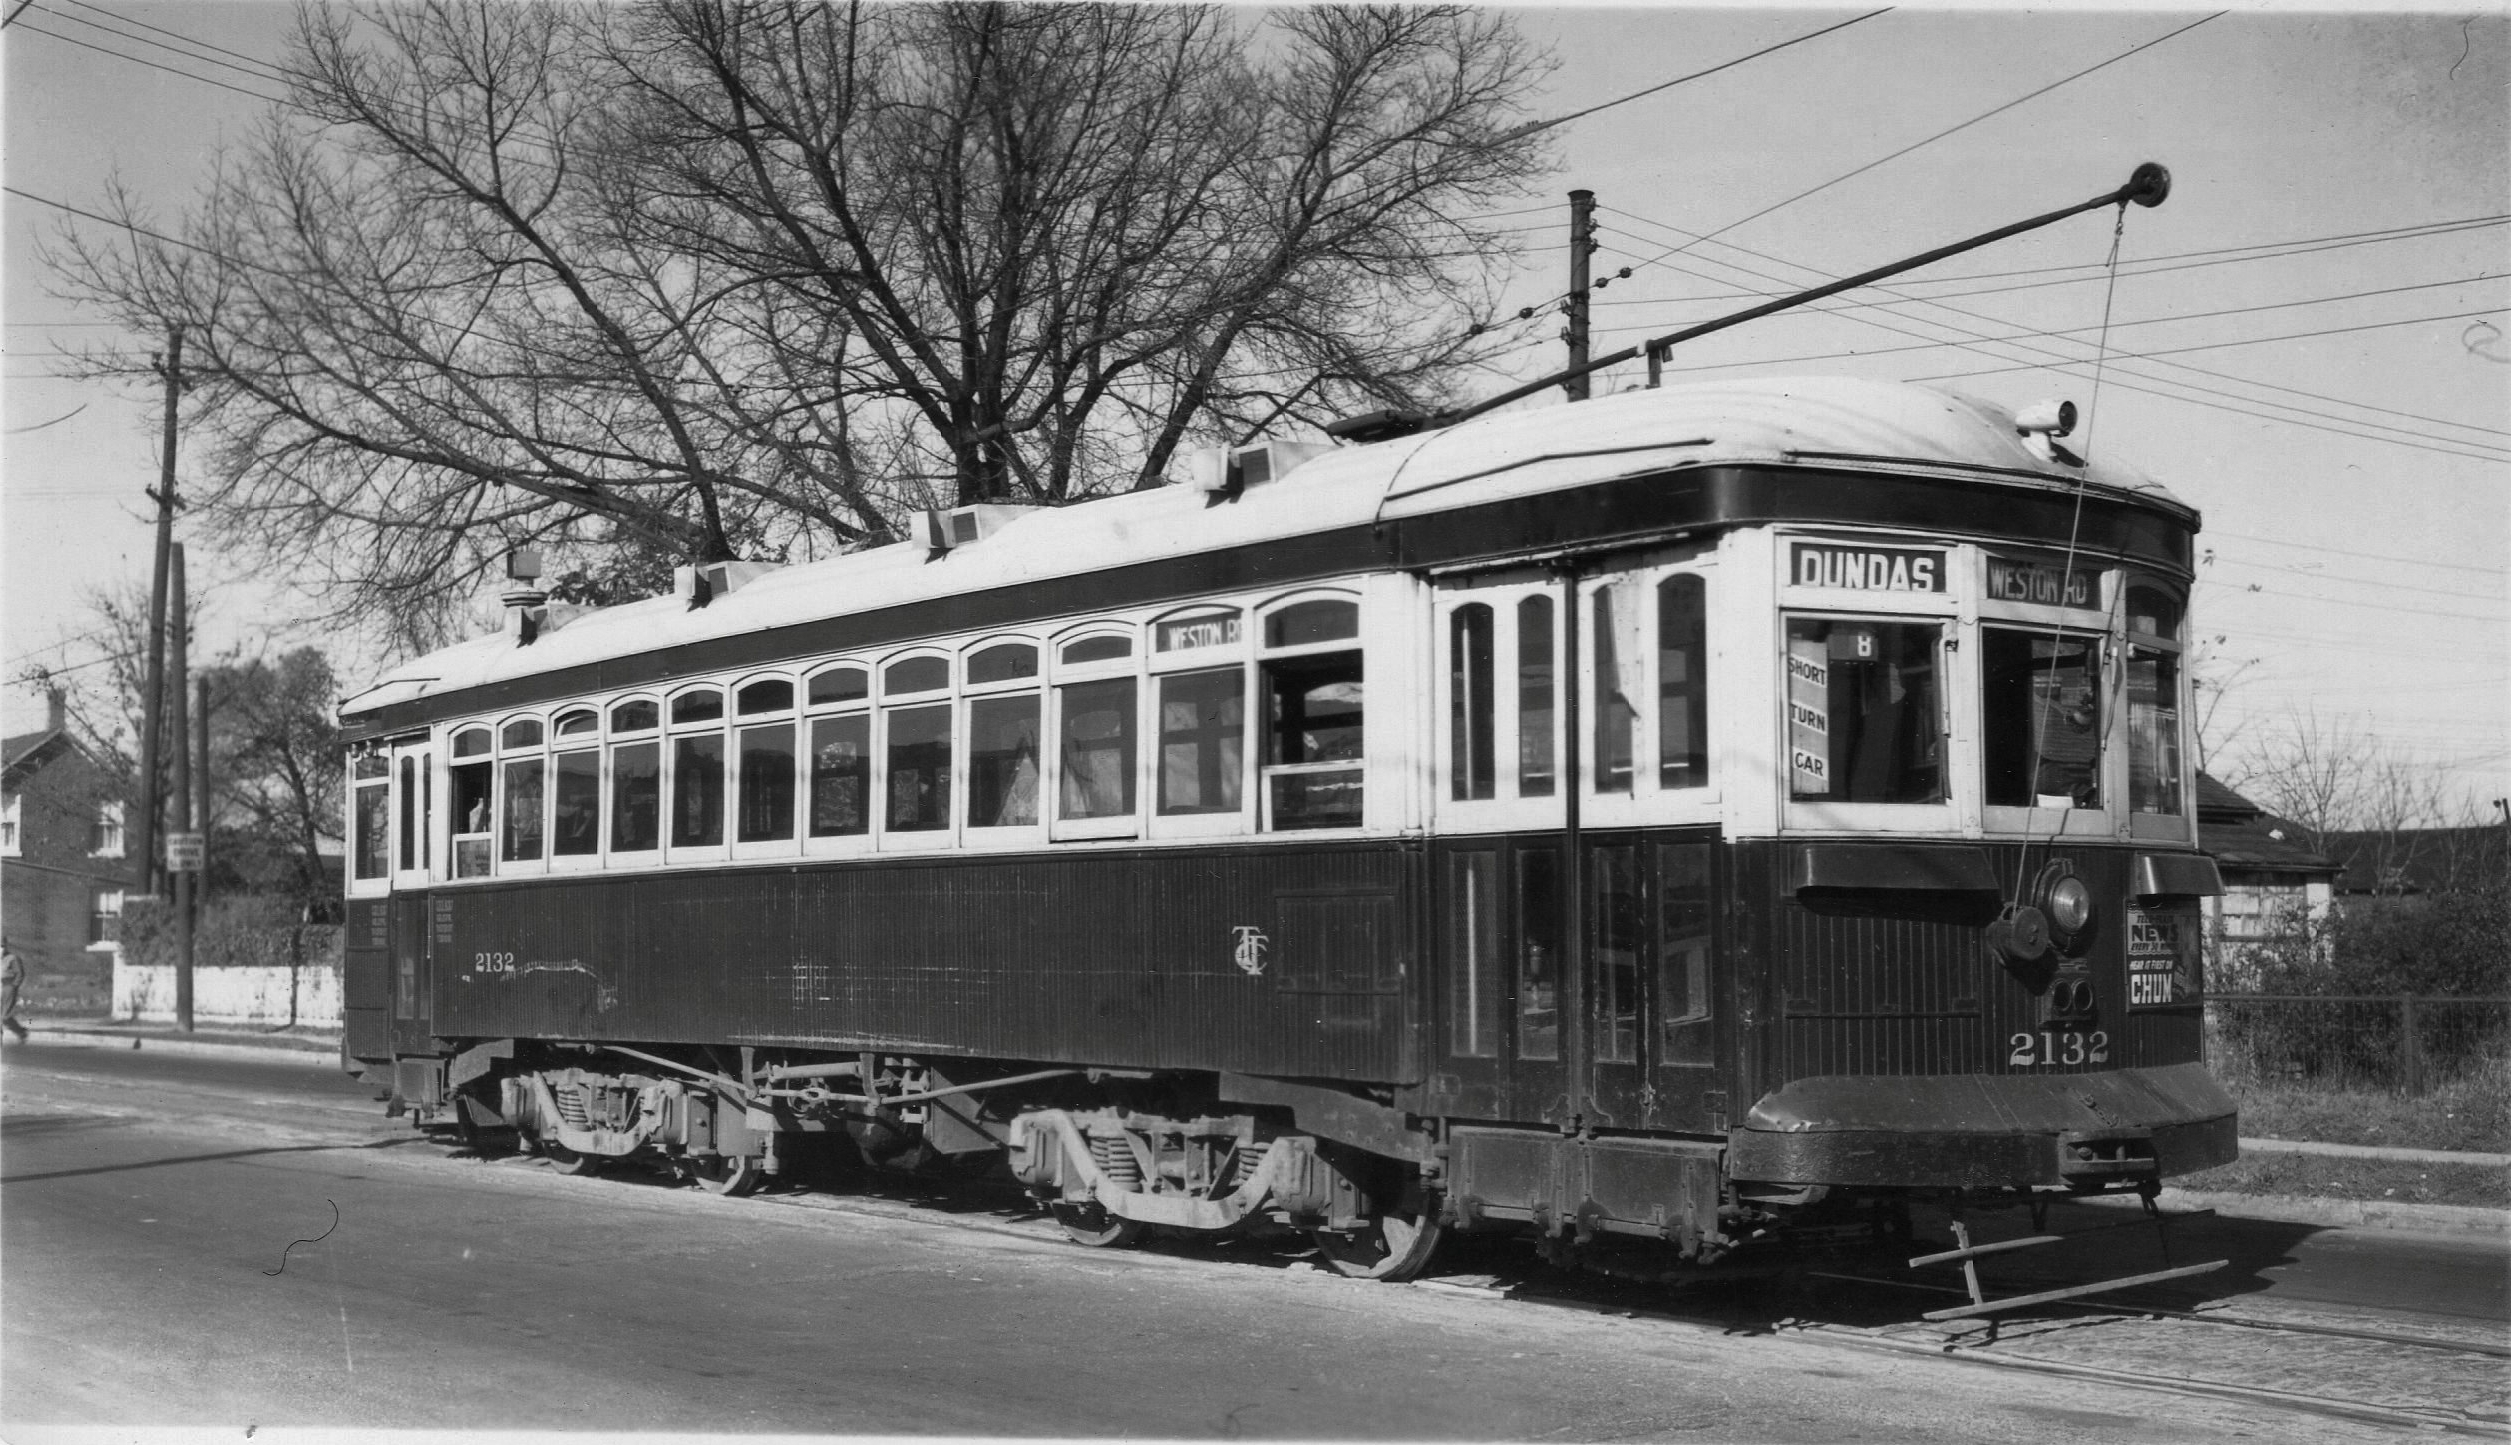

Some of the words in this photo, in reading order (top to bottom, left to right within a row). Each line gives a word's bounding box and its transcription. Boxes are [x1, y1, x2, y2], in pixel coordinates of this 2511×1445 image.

[1800, 549, 1934, 592] DUNDAS
[1990, 563, 2058, 602] WESTON
[2064, 573, 2087, 604] RD
[1168, 621, 1222, 650] WESTON
[1857, 633, 1872, 656] 8
[1788, 657, 1826, 685] SHORT
[1790, 703, 1826, 732] TURN
[1795, 752, 1824, 776] CAR
[2131, 924, 2178, 943] NEWS
[475, 952, 515, 973] 2132
[2131, 973, 2172, 1004] CHUM
[2009, 1031, 2109, 1066] 2132
